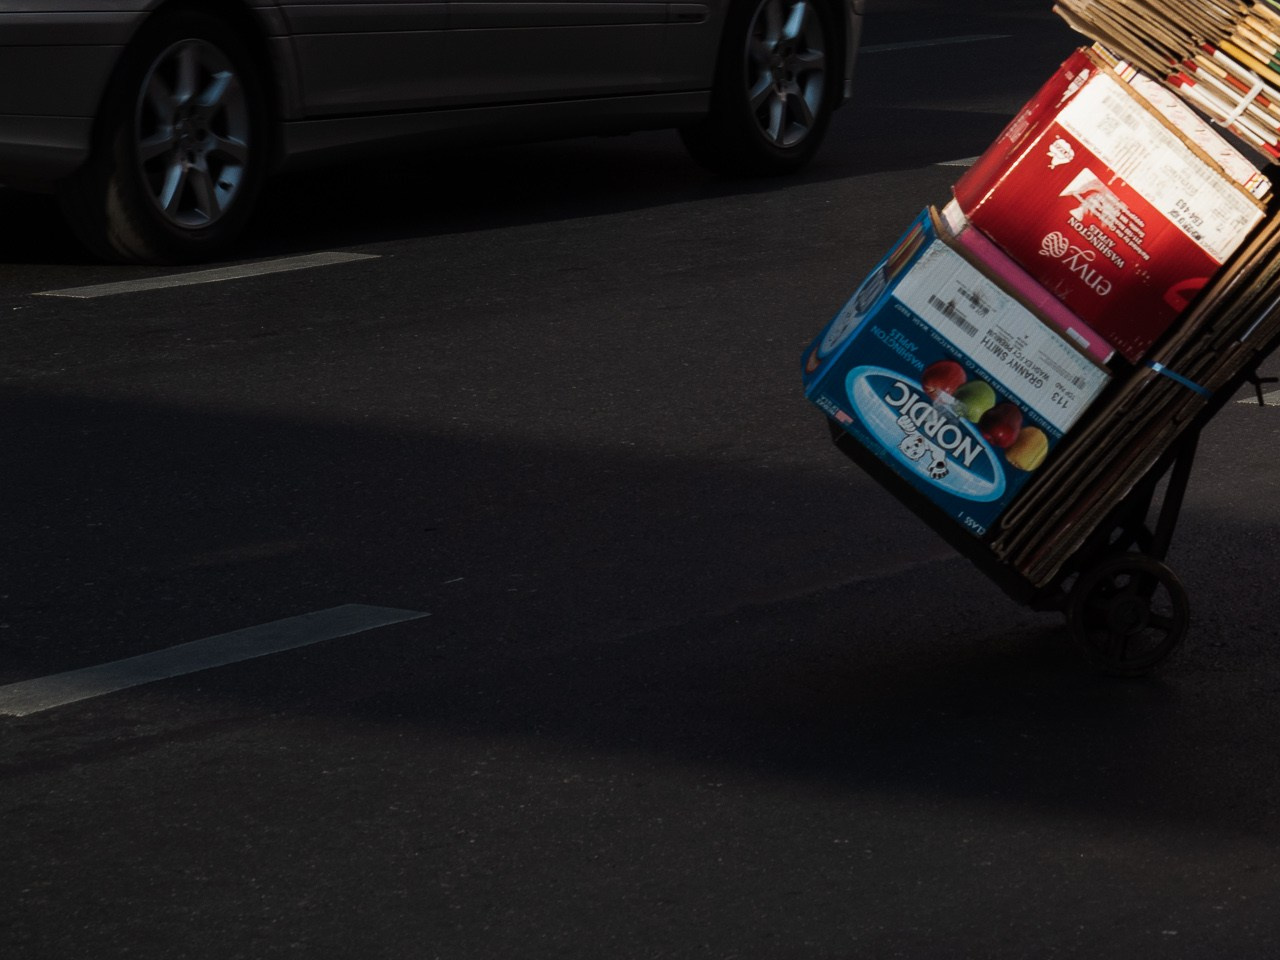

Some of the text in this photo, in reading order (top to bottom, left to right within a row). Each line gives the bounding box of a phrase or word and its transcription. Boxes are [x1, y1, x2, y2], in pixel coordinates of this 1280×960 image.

[1067, 215, 1125, 268] WASHINGTON
[1088, 222, 1115, 248] APPLES
[1063, 240, 1113, 297] envy
[870, 323, 925, 371] WASHINGTON
[889, 327, 918, 353] APPLES
[979, 335, 1009, 361] SMITH
[986, 327, 1014, 352] PREMIUM
[974, 366, 992, 382] FRUIT
[1005, 355, 1044, 389] GRANNY
[1031, 363, 1051, 381] WASH
[990, 379, 1021, 406] NORTHERN
[1050, 390, 1070, 409] 113
[884, 380, 984, 468] NORDIC
[1027, 409, 1062, 439] DISTRIBUTED
[963, 514, 986, 536] CLASS
